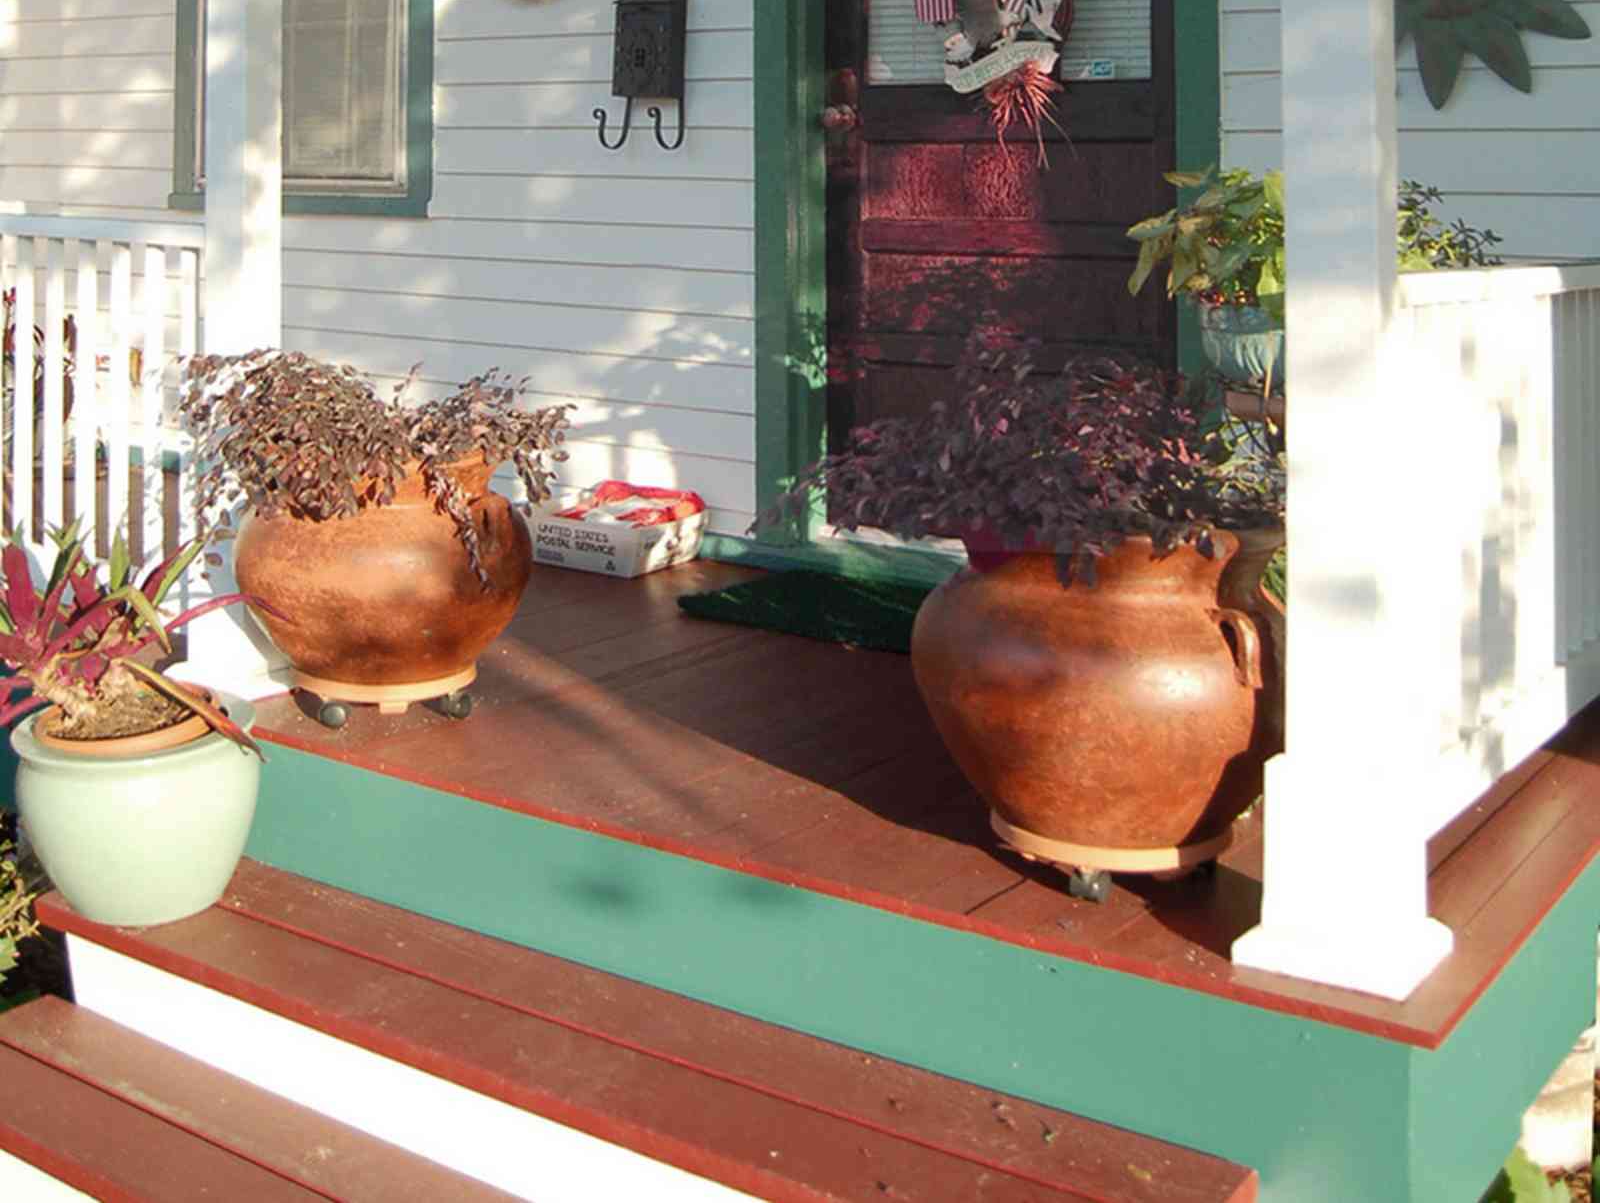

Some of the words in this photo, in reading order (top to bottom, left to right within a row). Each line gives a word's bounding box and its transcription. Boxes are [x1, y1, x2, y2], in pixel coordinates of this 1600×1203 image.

[538, 524, 572, 538] UNITED
[574, 528, 609, 543] STATES
[536, 534, 571, 550] POSTAL
[574, 540, 616, 557] SERVICE
